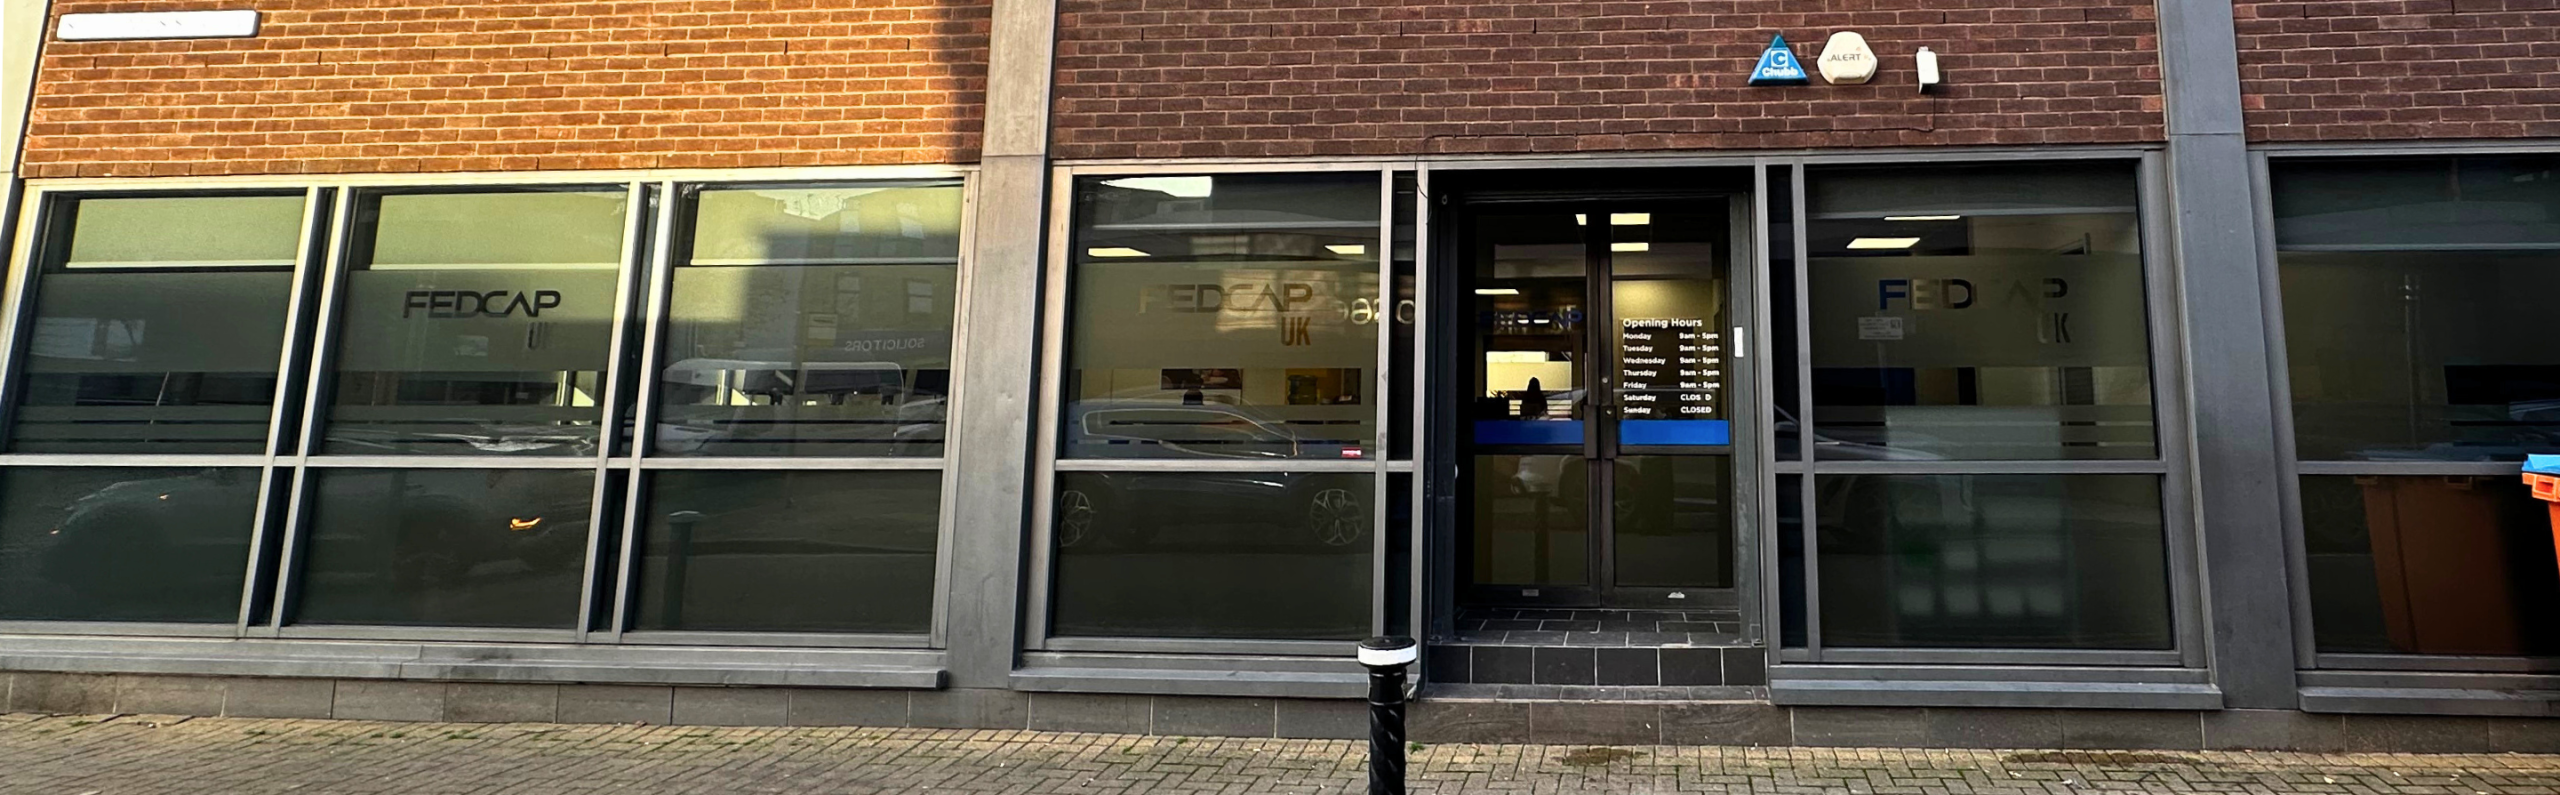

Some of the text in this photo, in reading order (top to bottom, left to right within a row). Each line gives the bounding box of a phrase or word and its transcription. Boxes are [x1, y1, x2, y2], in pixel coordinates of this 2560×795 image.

[1762, 67, 1799, 77] Chubb
[1137, 283, 1313, 314] FEDCAP
[403, 290, 561, 319] FEDCAP
[1622, 318, 1703, 329] Opening Hours
[1280, 316, 1311, 346] UK
[1623, 357, 1666, 365] Wednesday
[1623, 369, 1657, 377] Thursday
[1623, 394, 1656, 402] Saturday
[1623, 406, 1651, 414] Sunday
